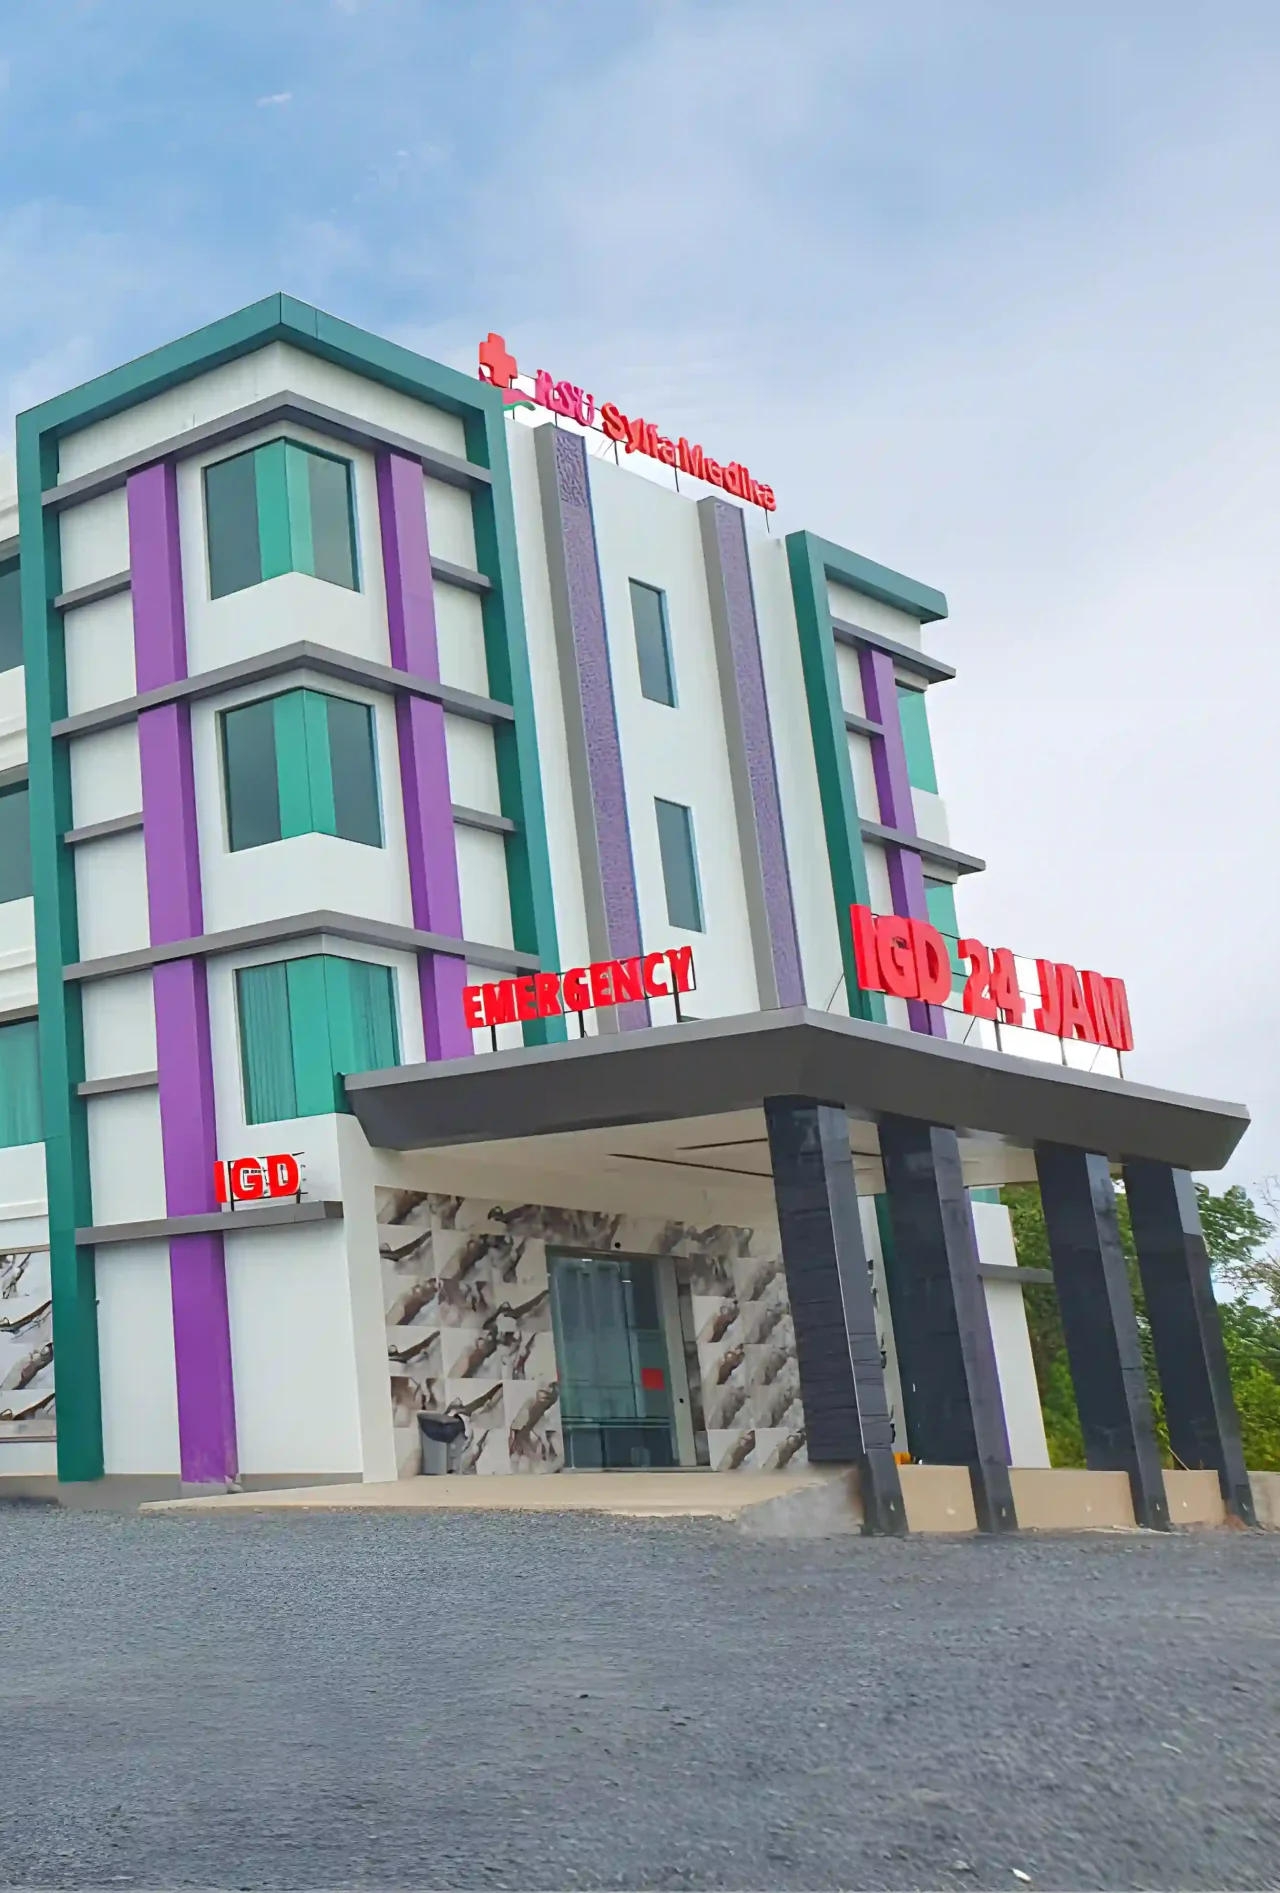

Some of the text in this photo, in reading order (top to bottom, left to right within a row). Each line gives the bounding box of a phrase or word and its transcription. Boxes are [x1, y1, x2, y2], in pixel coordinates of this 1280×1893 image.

[535, 369, 595, 427] RSU
[462, 945, 694, 1029] EMERGENCY
[850, 903, 1134, 1051] IGD 24 JAM
[214, 1153, 299, 1203] IGD
